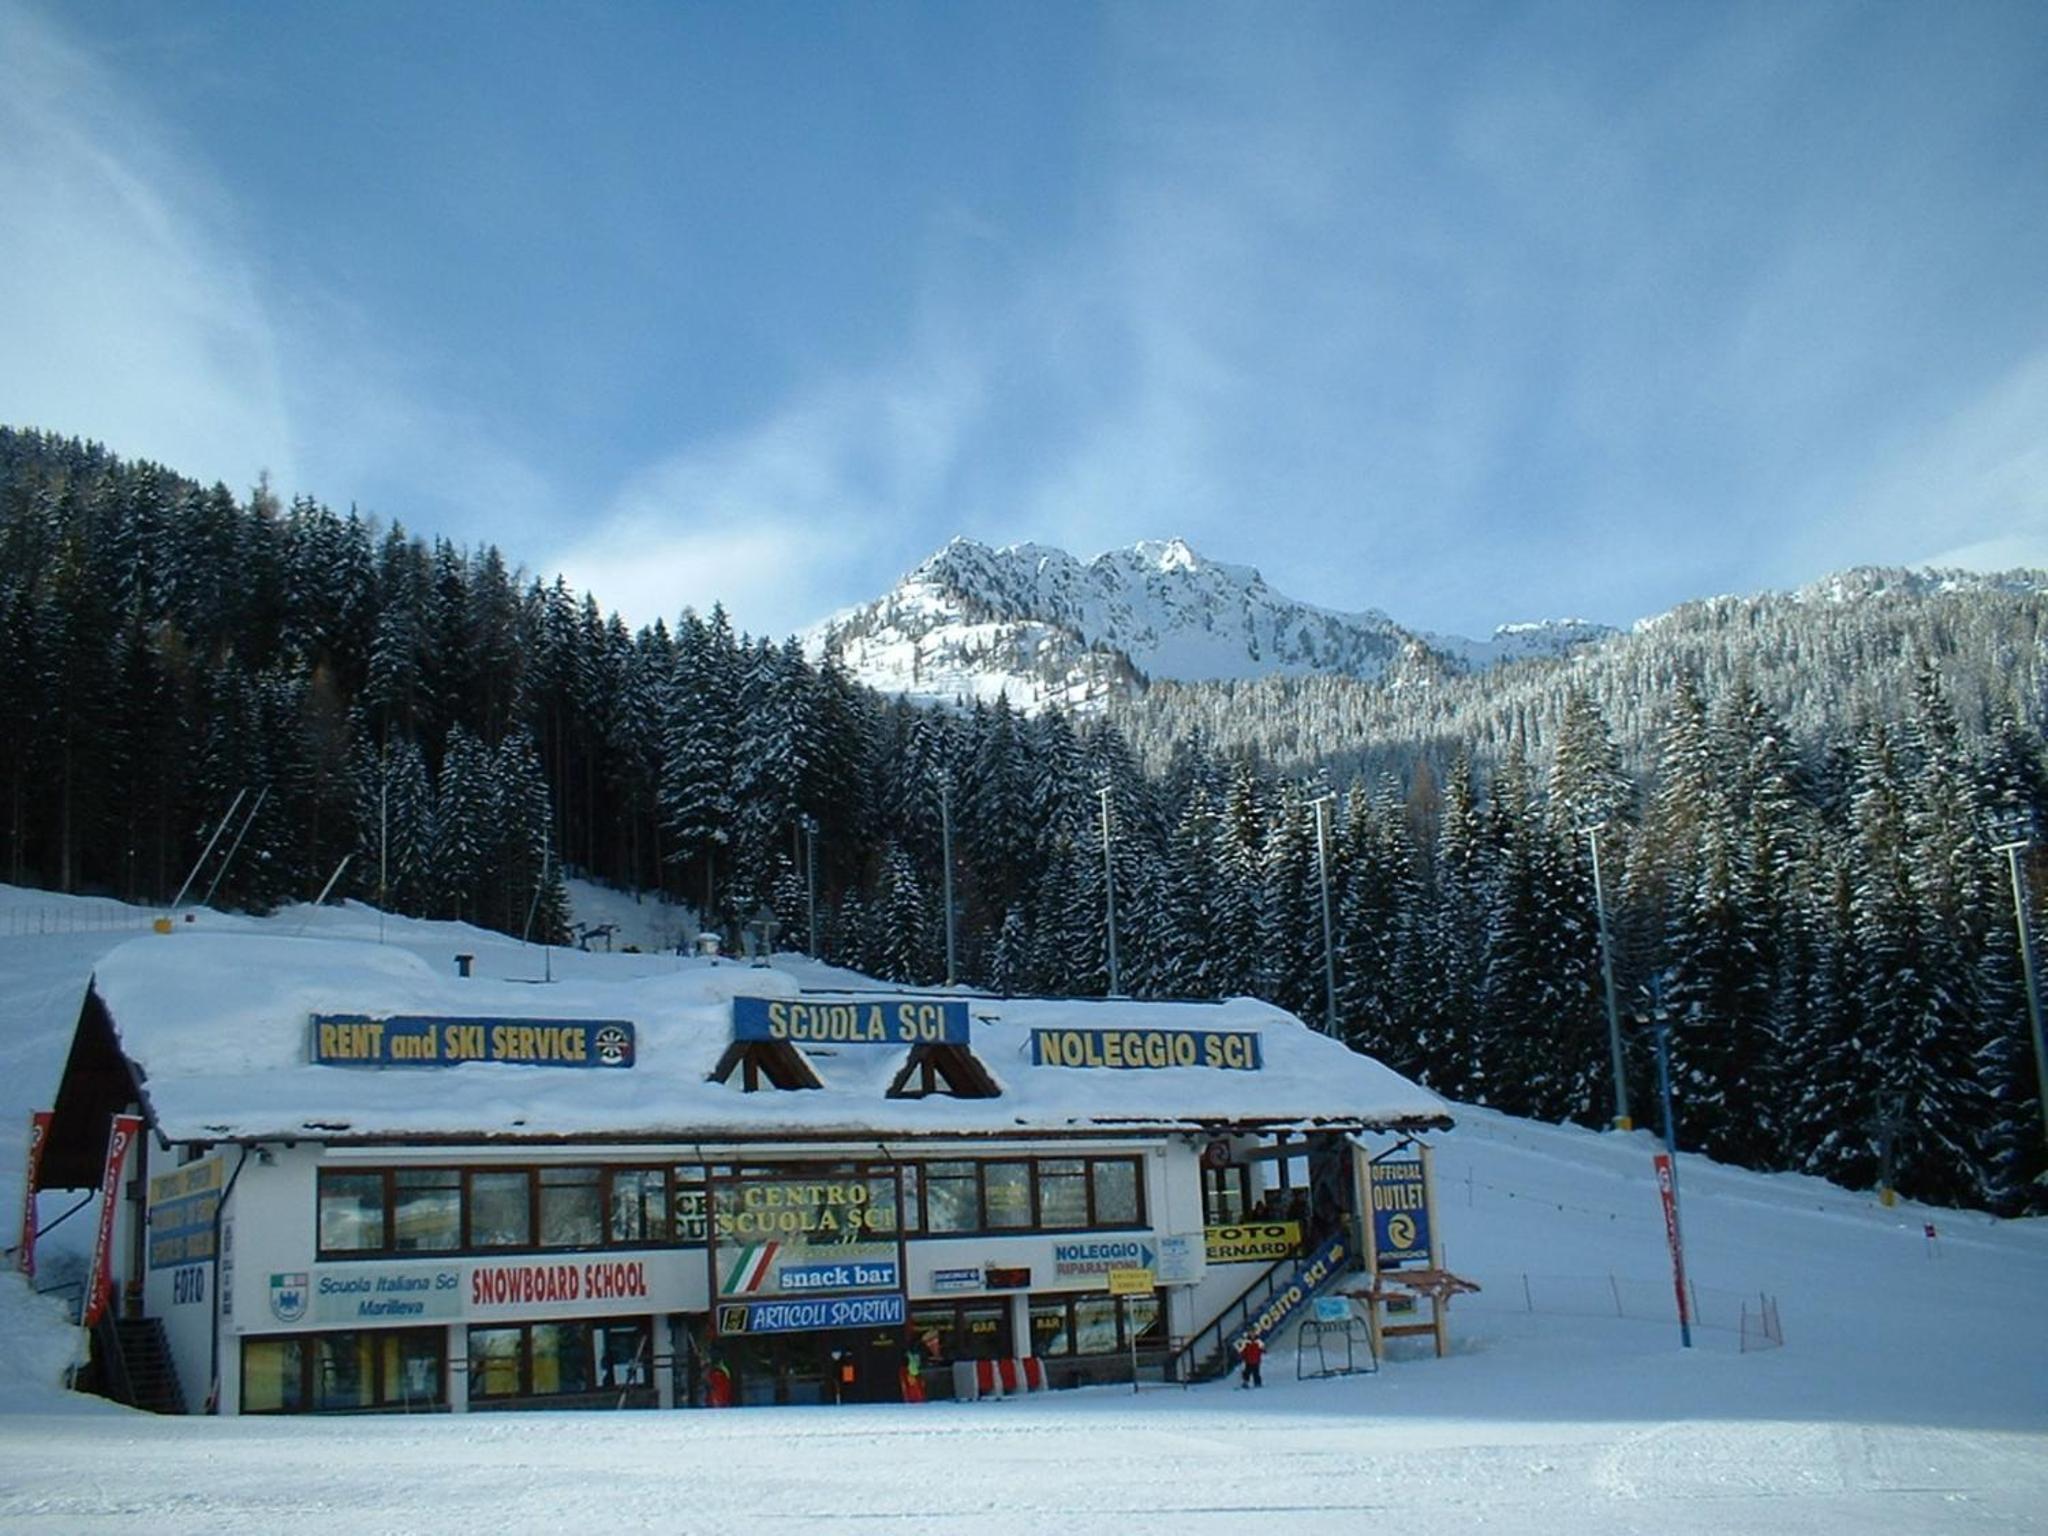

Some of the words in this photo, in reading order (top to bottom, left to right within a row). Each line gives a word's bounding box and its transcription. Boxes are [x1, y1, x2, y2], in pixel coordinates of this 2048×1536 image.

[769, 1002, 886, 1040] SCUOLA
[899, 1003, 945, 1041] SCI
[320, 1023, 384, 1059] RENT
[390, 1024, 437, 1059] and
[445, 1025, 484, 1060] SKI
[492, 1026, 587, 1061] SERVICE
[1039, 1032, 1196, 1067] NOLEGGIO
[1205, 1034, 1253, 1068] SCI
[1372, 1163, 1422, 1180] OFFICIAL
[744, 1184, 868, 1207] CENTRO
[1374, 1184, 1423, 1211] OUTLET
[719, 1209, 839, 1233] SCUOLA
[849, 1207, 897, 1232] SCI
[1204, 1226, 1286, 1241] FOTO
[1056, 1243, 1138, 1261] NOLEGGIO
[1205, 1242, 1293, 1258] ERNARDI
[173, 1266, 205, 1304] FOTO
[319, 1277, 371, 1294] Scuola
[376, 1274, 431, 1291] Italiana
[435, 1272, 460, 1289] Sci
[471, 1265, 579, 1304] SNOWBOARD
[585, 1261, 646, 1299] SCHOOL
[781, 1267, 848, 1289] snack
[855, 1266, 893, 1284] bar
[753, 1303, 825, 1330] ARTICOLI
[832, 1300, 900, 1325] SPORTIVI
[1233, 1286, 1302, 1352] DPOSITO
[1302, 1260, 1328, 1288] SCI
